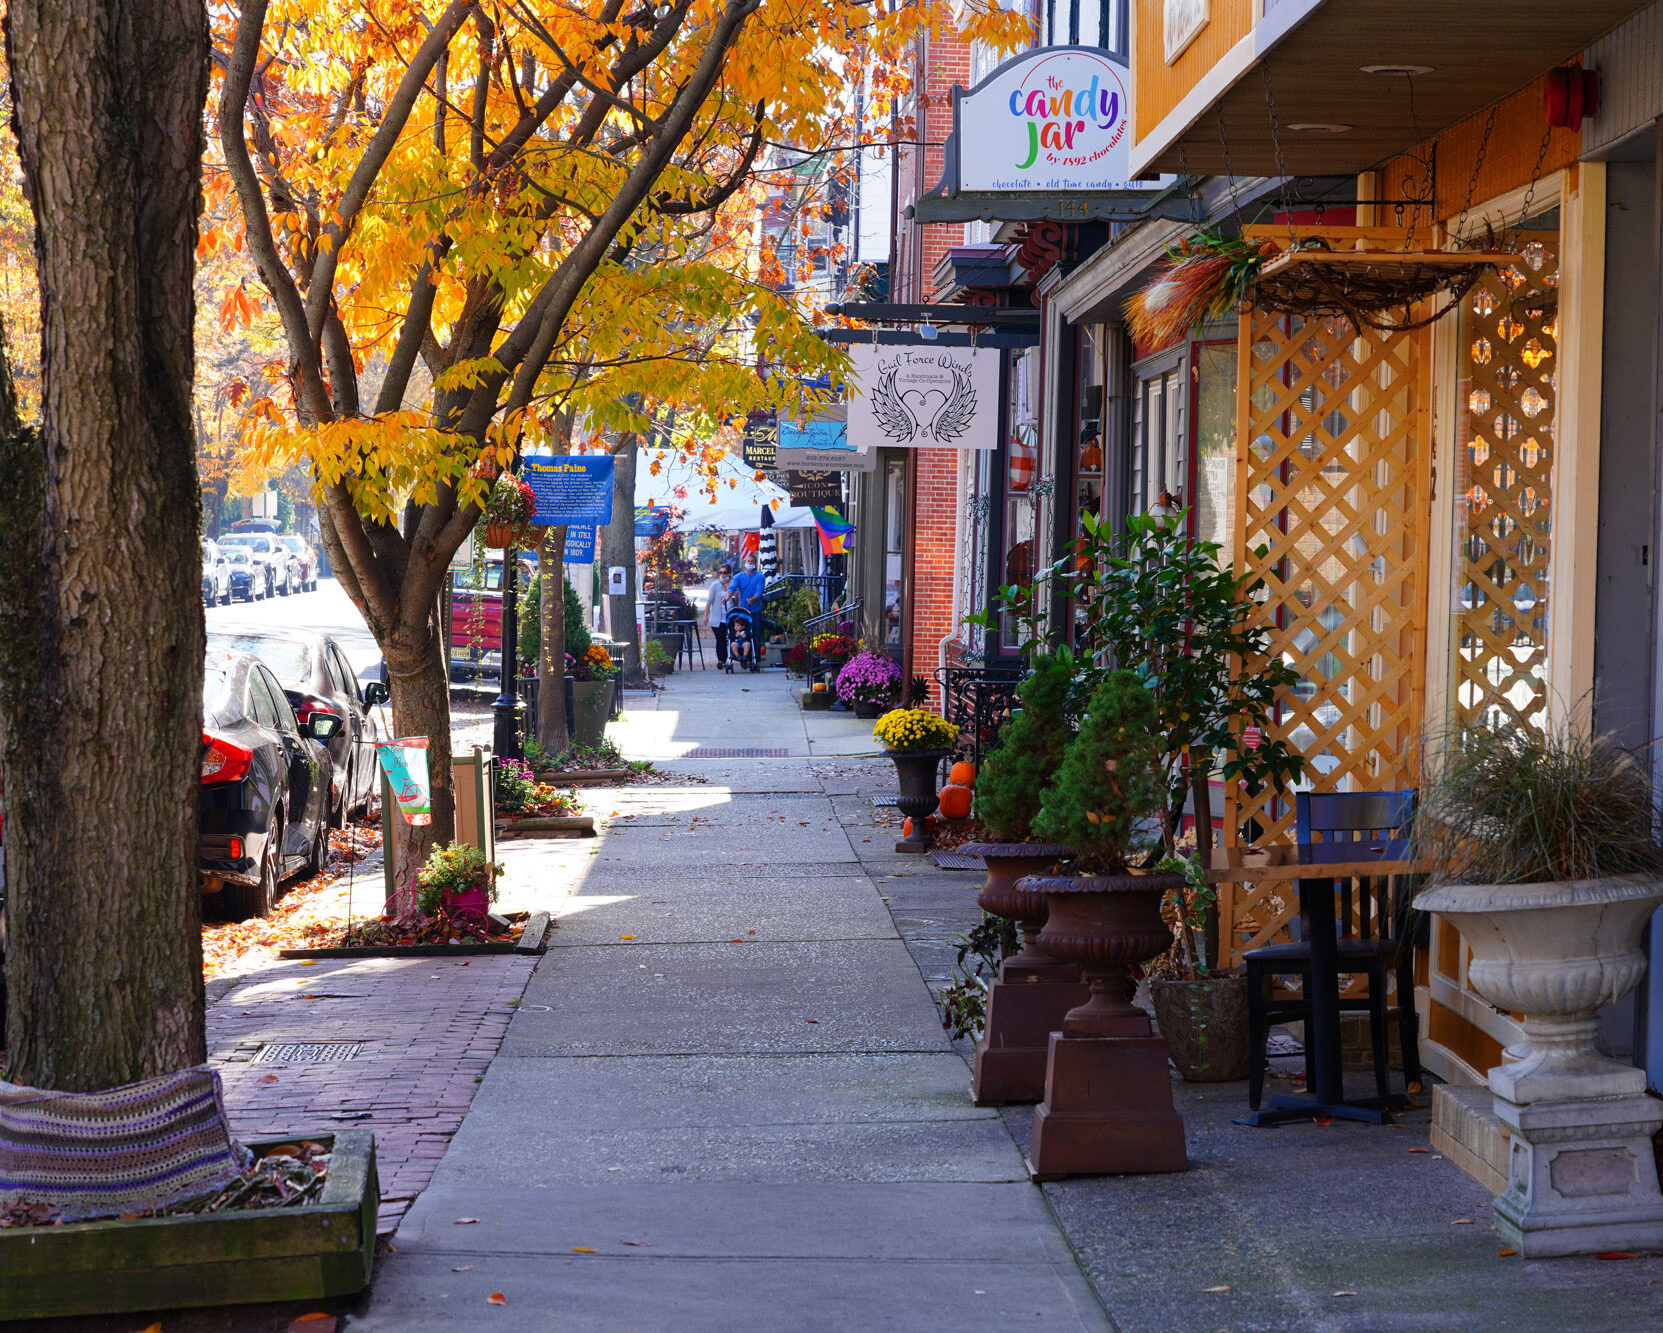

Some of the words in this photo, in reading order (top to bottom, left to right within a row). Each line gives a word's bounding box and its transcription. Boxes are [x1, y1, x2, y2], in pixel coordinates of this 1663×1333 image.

[1046, 75, 1064, 91] the
[1009, 74, 1119, 130] candy
[1014, 120, 1086, 170] jar
[1046, 154, 1061, 166] by
[1062, 156, 1087, 167] 1892
[1088, 118, 1128, 163] chocolates
[992, 178, 1031, 189] chocolate
[1046, 178, 1060, 189] old
[1063, 178, 1083, 189] time
[1085, 178, 1112, 190] candy
[1122, 180, 1144, 190] gifts
[1058, 200, 1088, 217] 144
[877, 354, 902, 375] Gail
[903, 351, 936, 367] Force
[937, 351, 973, 378] Winds
[531, 464, 562, 472] Thomas
[563, 464, 587, 472] Paine
[578, 531, 593, 540] 1783.
[570, 548, 584, 557] 1809.
